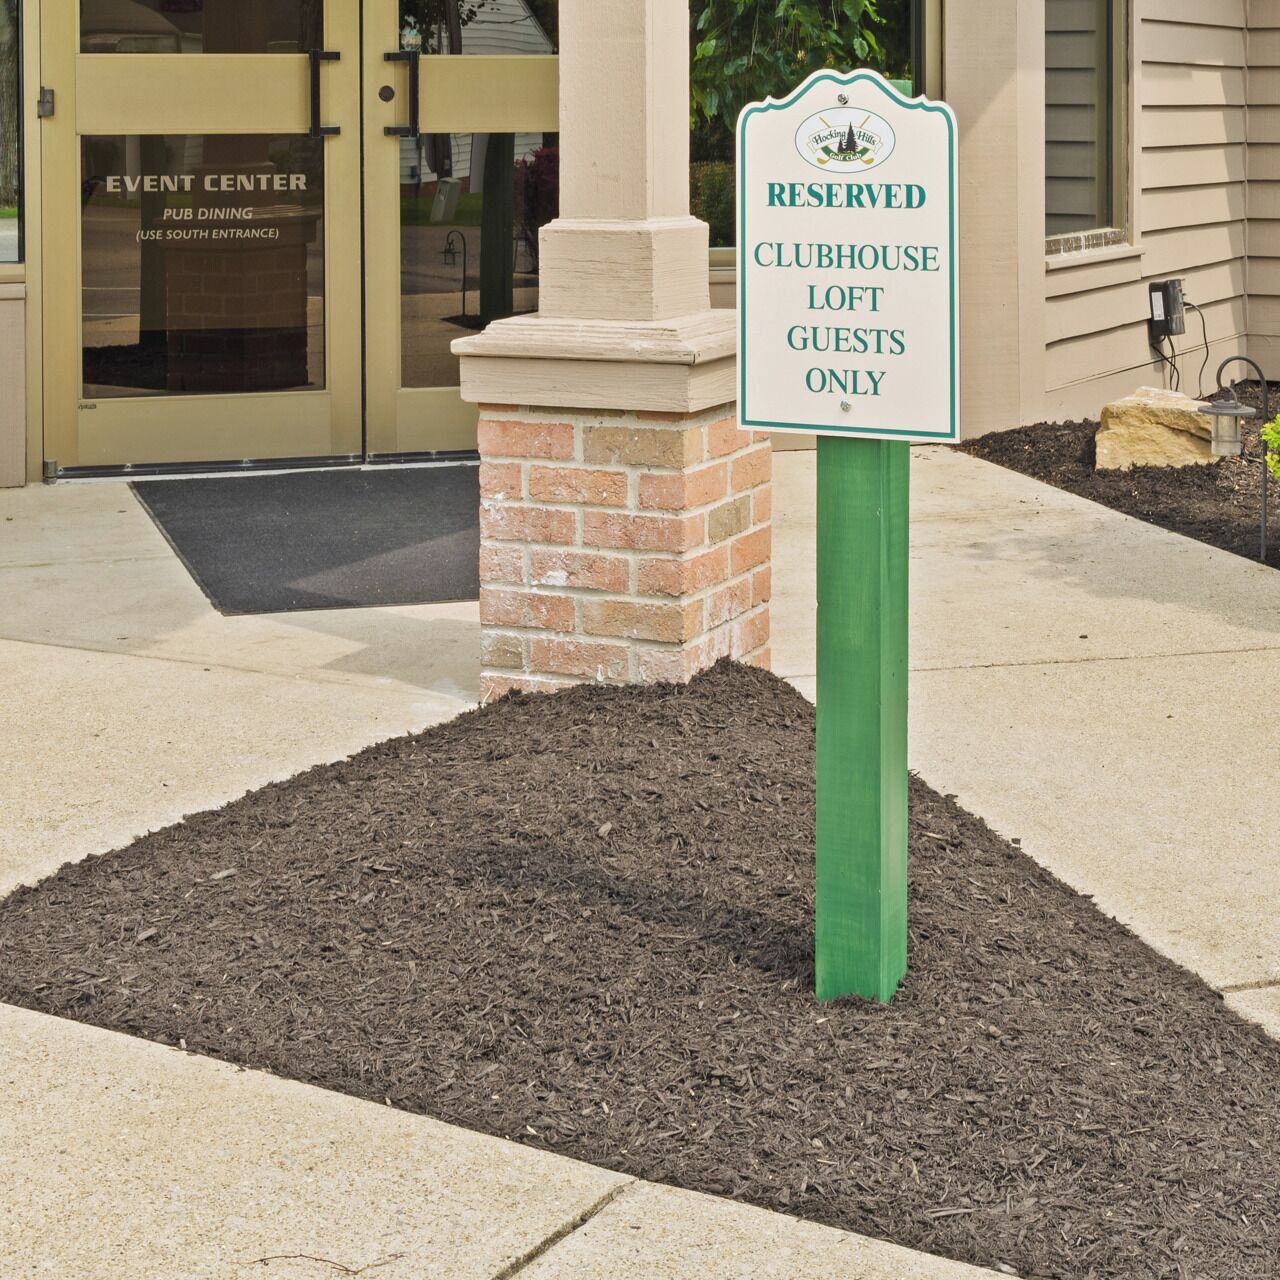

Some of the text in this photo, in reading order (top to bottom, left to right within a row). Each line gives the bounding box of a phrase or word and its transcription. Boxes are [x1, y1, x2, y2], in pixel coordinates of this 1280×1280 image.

[813, 129, 876, 146] Hocking Hills
[830, 152, 862, 161] Golf Club
[106, 173, 307, 192] EVENT CENTER
[766, 182, 926, 209] RESERVED
[163, 207, 253, 220] PUB DINING
[136, 228, 279, 242] (USE SOUTH ENTRANCE)
[754, 242, 940, 272] CLUBHOUSE
[807, 285, 884, 312] LOFT
[787, 326, 905, 355] GUESTS
[805, 367, 886, 396] ONLY
